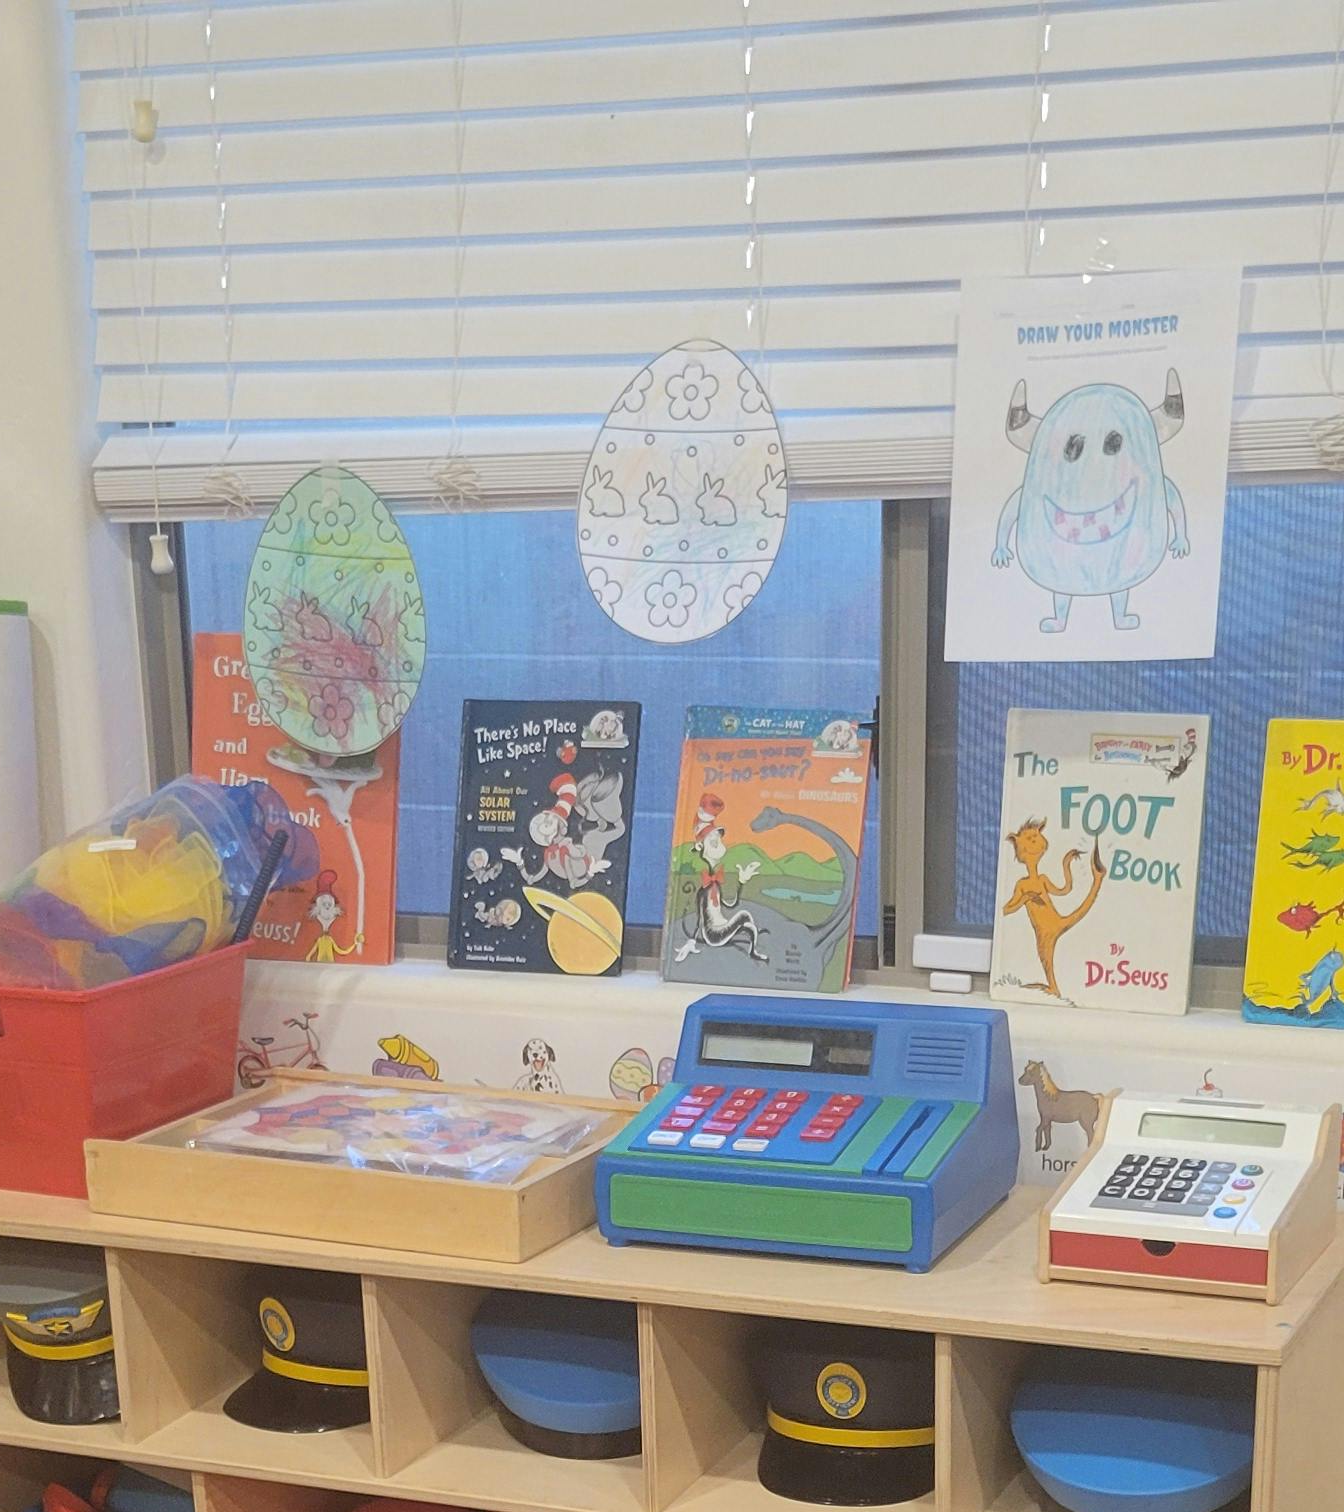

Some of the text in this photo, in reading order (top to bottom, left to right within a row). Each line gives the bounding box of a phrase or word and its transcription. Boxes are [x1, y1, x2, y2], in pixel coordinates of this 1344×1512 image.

[1017, 314, 1179, 345] DRAW YOUR MONSTER
[213, 655, 251, 680] Gre
[231, 692, 274, 726] Egg
[474, 718, 577, 745] There's No Place
[214, 737, 247, 755] and
[477, 737, 548, 764] Like Space!
[1014, 752, 1059, 777] The
[1281, 751, 1301, 769] By
[1303, 744, 1342, 775] Dr.
[480, 786, 491, 794] All
[492, 786, 514, 795] About
[480, 797, 510, 808] SOLAR
[478, 811, 516, 822] SYSTEM
[1060, 786, 1175, 839] FOOT
[1109, 849, 1182, 891] BOOK
[253, 922, 300, 944] euss!
[1110, 943, 1124, 956] By
[1085, 960, 1168, 990] Dr. Seuss
